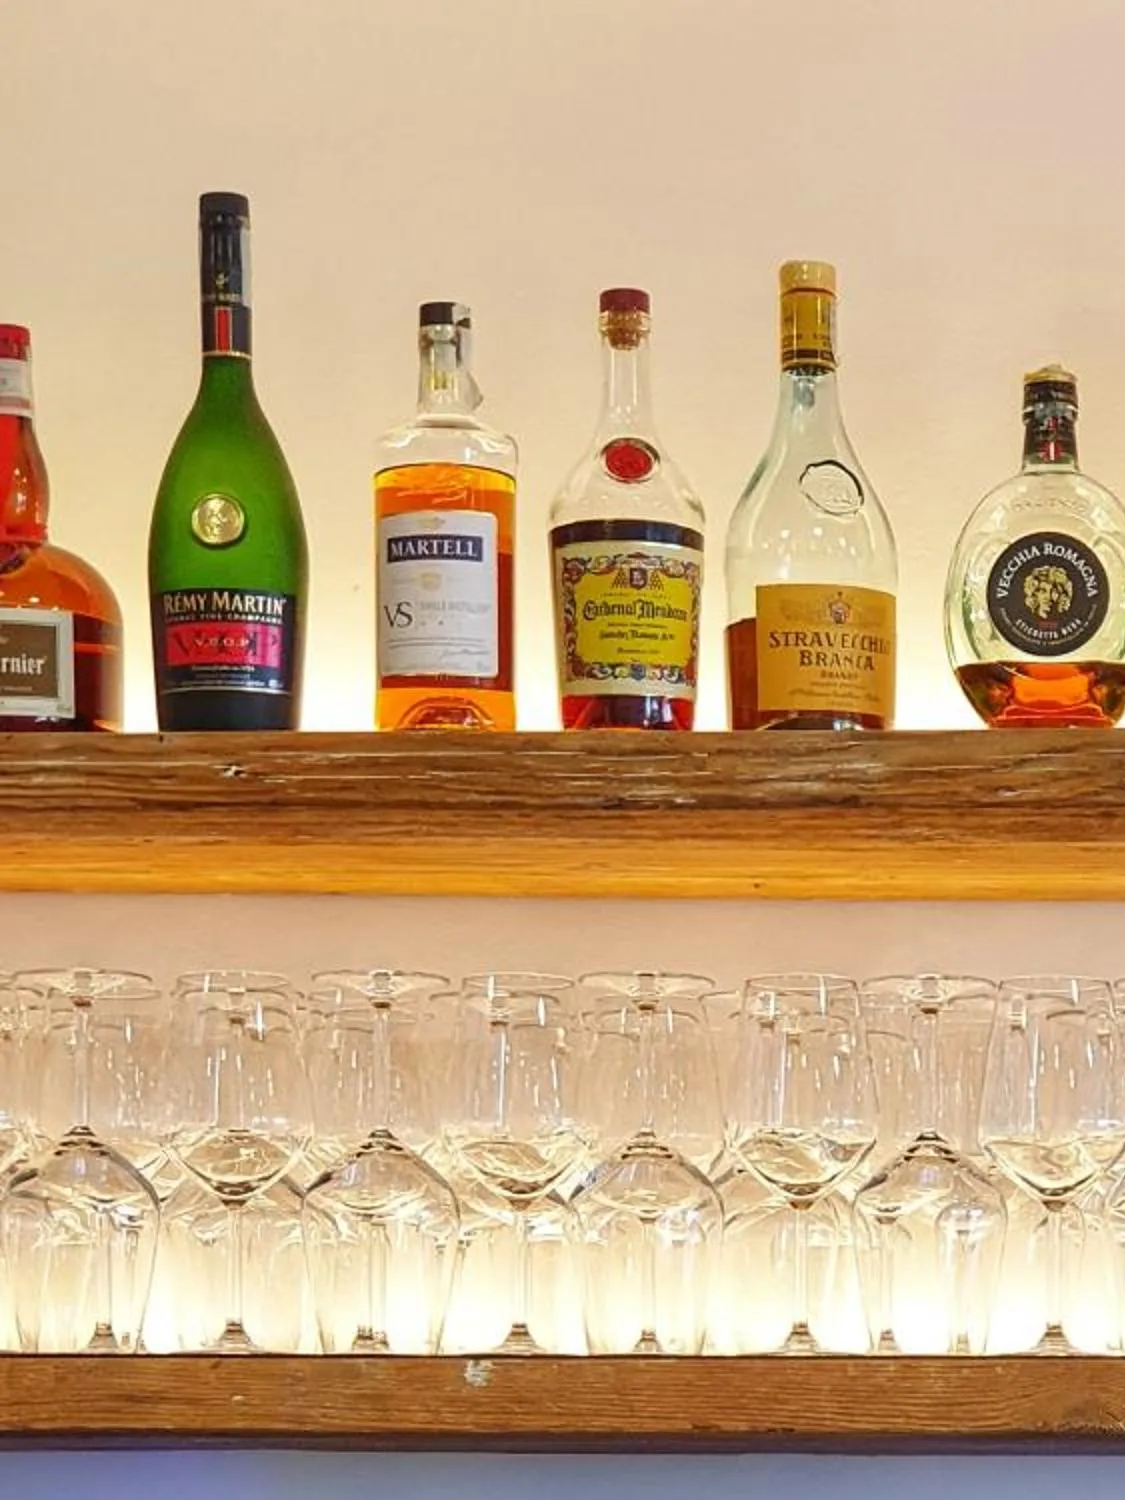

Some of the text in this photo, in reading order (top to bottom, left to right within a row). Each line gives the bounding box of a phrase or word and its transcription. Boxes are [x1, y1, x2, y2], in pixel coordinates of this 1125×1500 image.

[390, 539, 479, 556] MARTELL
[996, 541, 1099, 599] VECCHIA ROMAGNA
[163, 591, 284, 615] RÉMY MARTIN
[384, 601, 414, 628] VS
[1, 653, 45, 675] rnier
[799, 650, 875, 671] BRANCA
